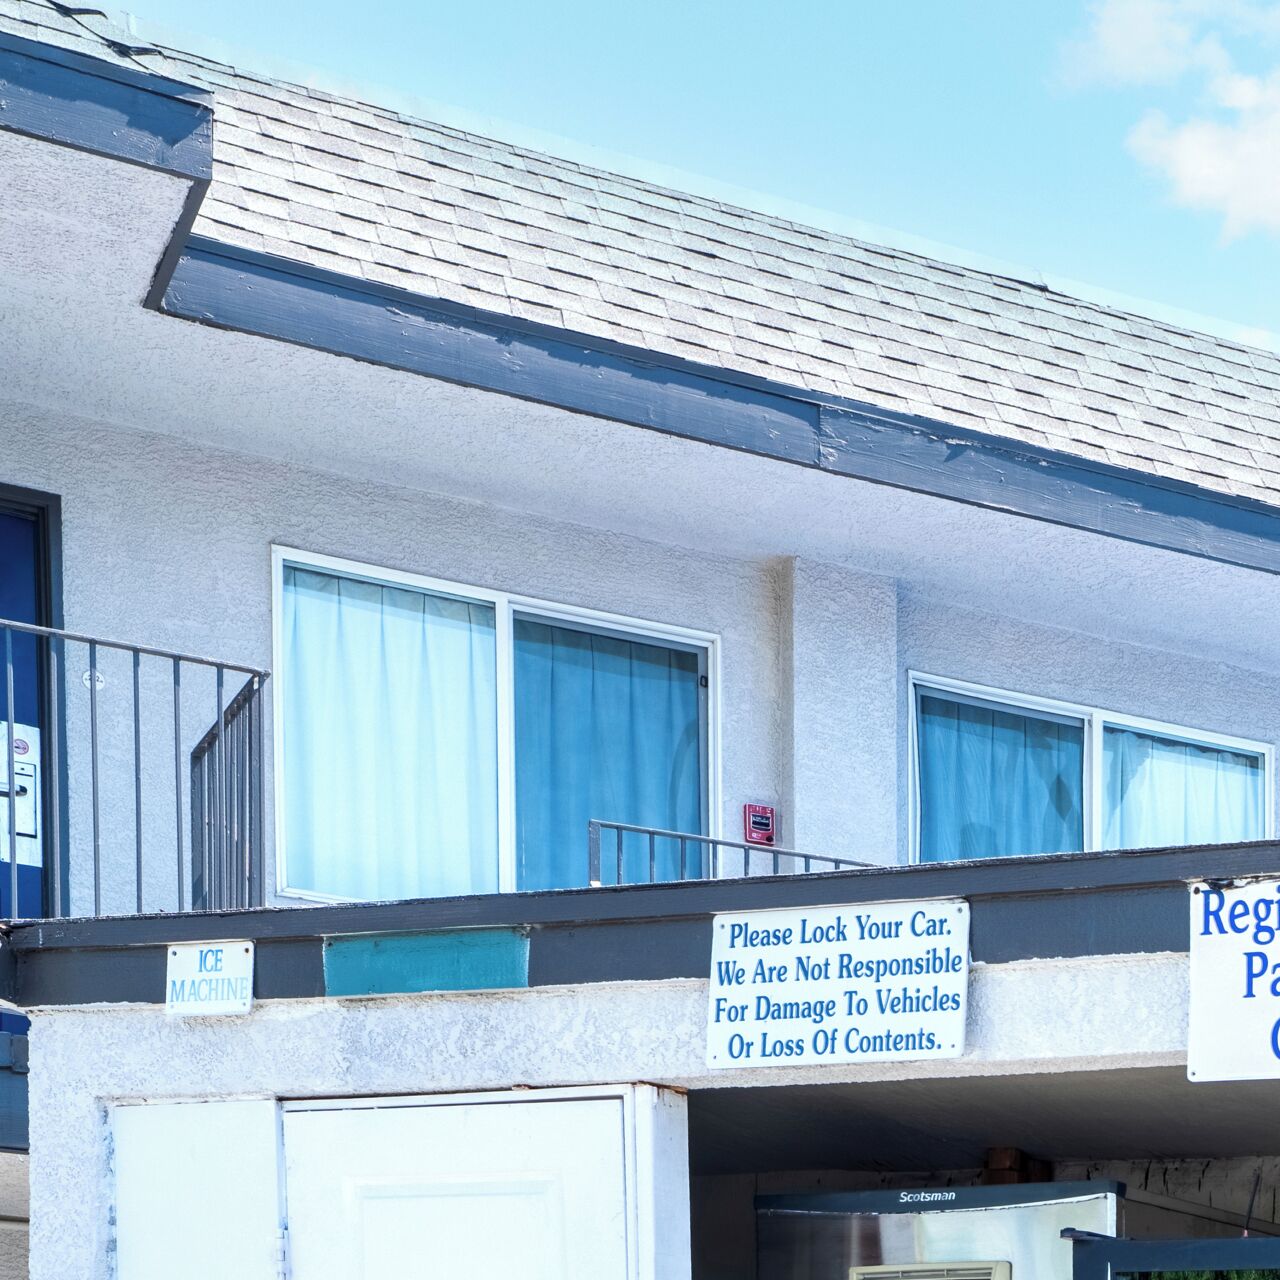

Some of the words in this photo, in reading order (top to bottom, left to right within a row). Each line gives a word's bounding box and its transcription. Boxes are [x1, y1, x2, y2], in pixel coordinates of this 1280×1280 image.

[729, 922, 793, 949] Please
[800, 916, 848, 944] Lock
[856, 914, 903, 941] Your
[910, 911, 952, 938] Car.
[198, 949, 224, 973] ICE
[716, 960, 746, 987] We
[752, 959, 788, 984] Are
[794, 956, 831, 982] Not
[838, 947, 962, 982] Responsible
[169, 977, 249, 1003] MACHINE
[714, 997, 748, 1023] For
[755, 995, 836, 1024] Damage
[843, 990, 869, 1016] To
[876, 985, 961, 1014] Vehicles
[728, 1033, 754, 1060] Or
[760, 1032, 804, 1058] Loss
[812, 1028, 838, 1055] Of
[844, 1027, 942, 1054] Contents.
[899, 1191, 956, 1202] Scotsman
